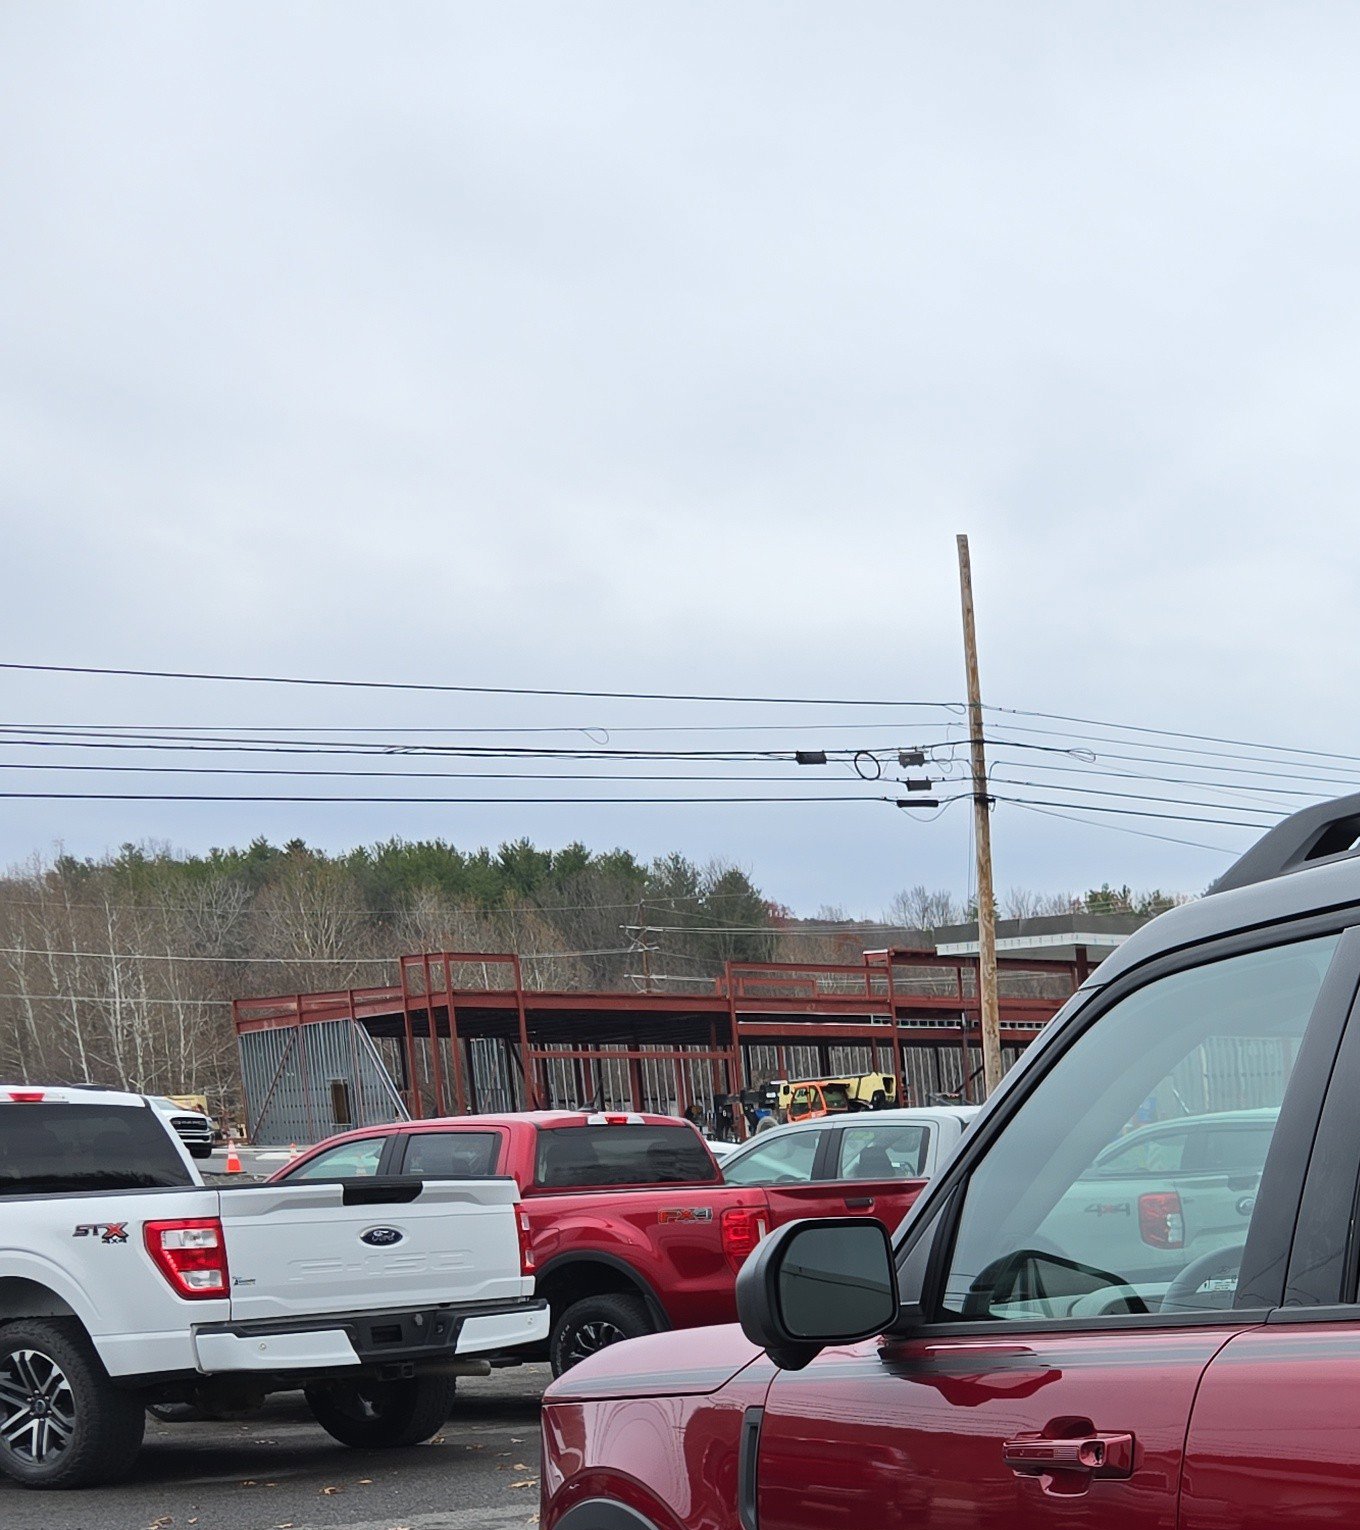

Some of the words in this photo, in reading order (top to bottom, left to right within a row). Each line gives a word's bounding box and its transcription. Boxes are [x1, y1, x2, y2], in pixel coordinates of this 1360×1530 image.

[658, 1207, 713, 1224] FX4
[72, 1222, 129, 1238] STX
[288, 1250, 476, 1282] F-150
